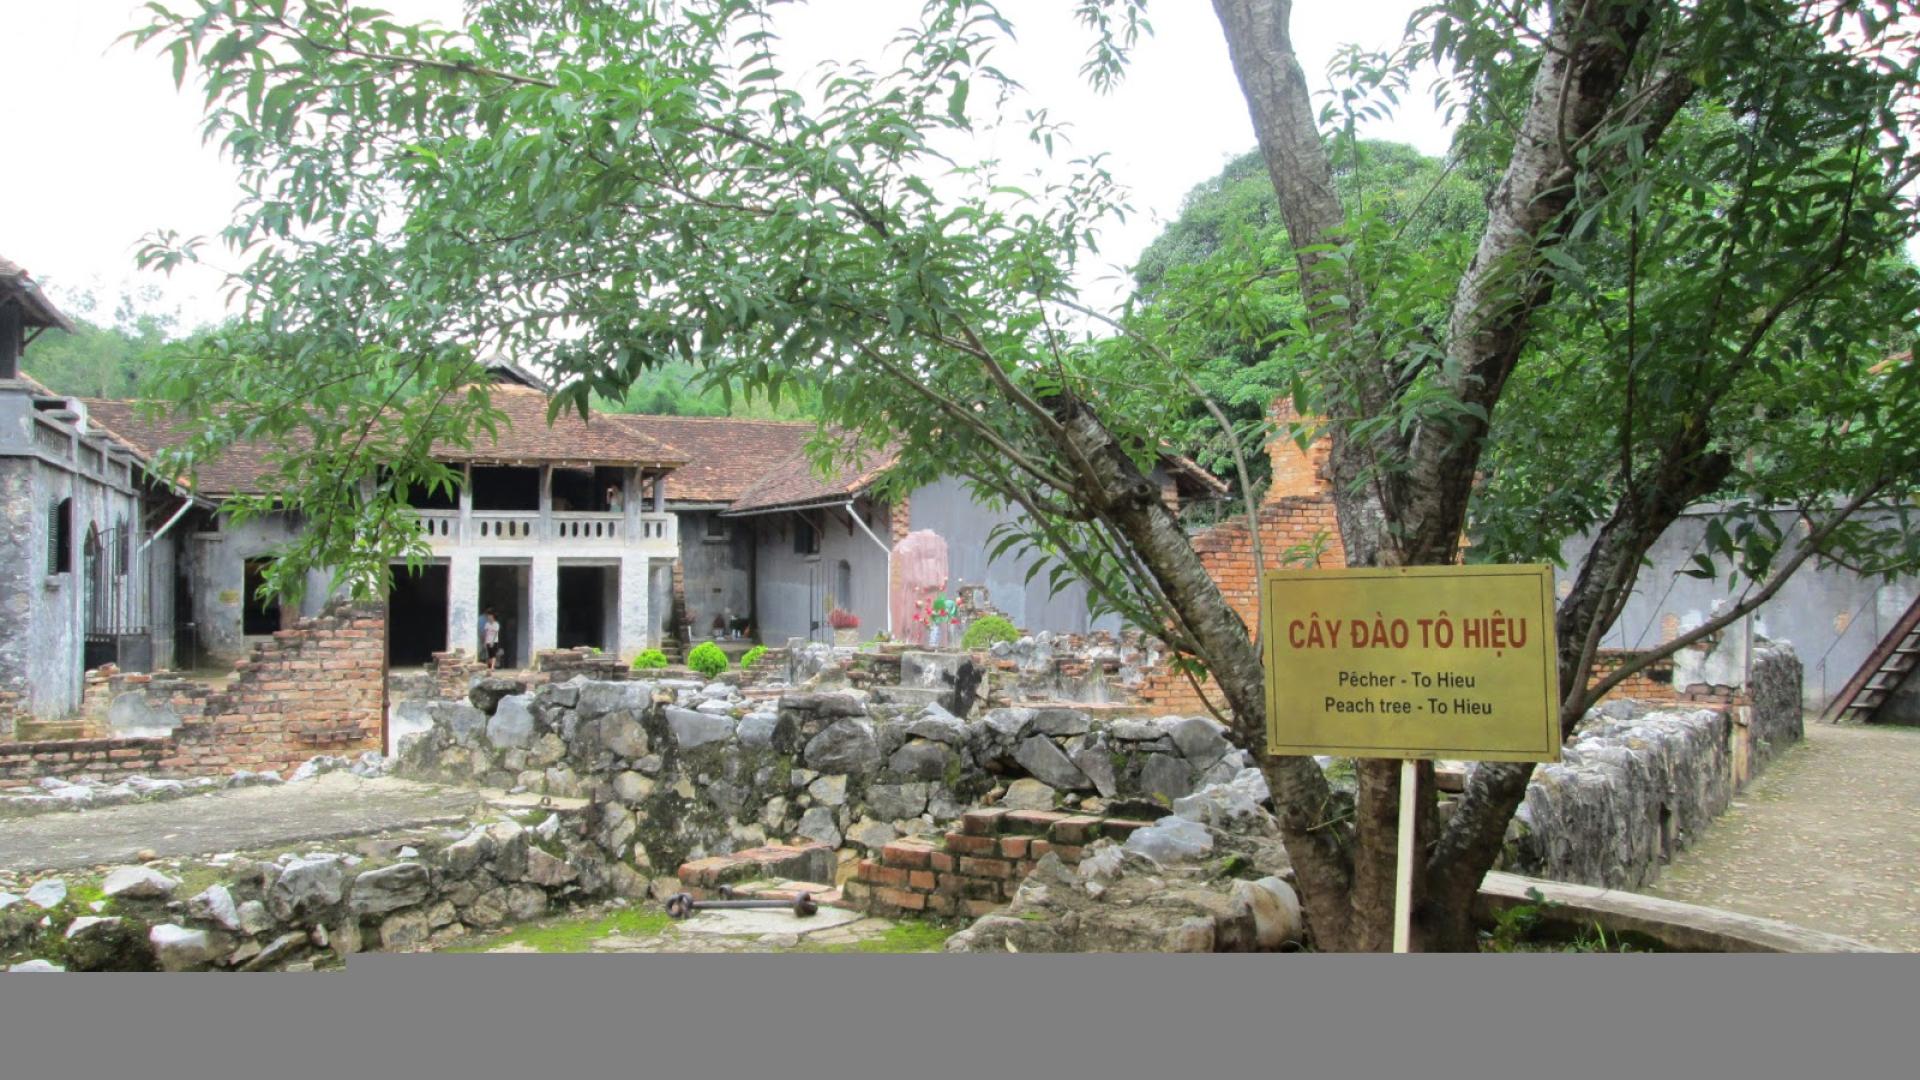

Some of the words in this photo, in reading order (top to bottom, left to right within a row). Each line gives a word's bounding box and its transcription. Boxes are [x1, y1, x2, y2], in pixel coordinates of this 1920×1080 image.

[1288, 611, 1342, 649] CÂY
[1350, 611, 1409, 649] ĐÀO
[1417, 610, 1454, 649] TÔ
[1463, 609, 1527, 658] HIỆU
[1338, 671, 1395, 688] Pêcher
[1411, 672, 1432, 688] To
[1437, 671, 1476, 688] Hieu
[1325, 697, 1375, 713] Peach
[1380, 698, 1412, 714] tree
[1427, 698, 1448, 715] To
[1453, 698, 1492, 715] Hieu
